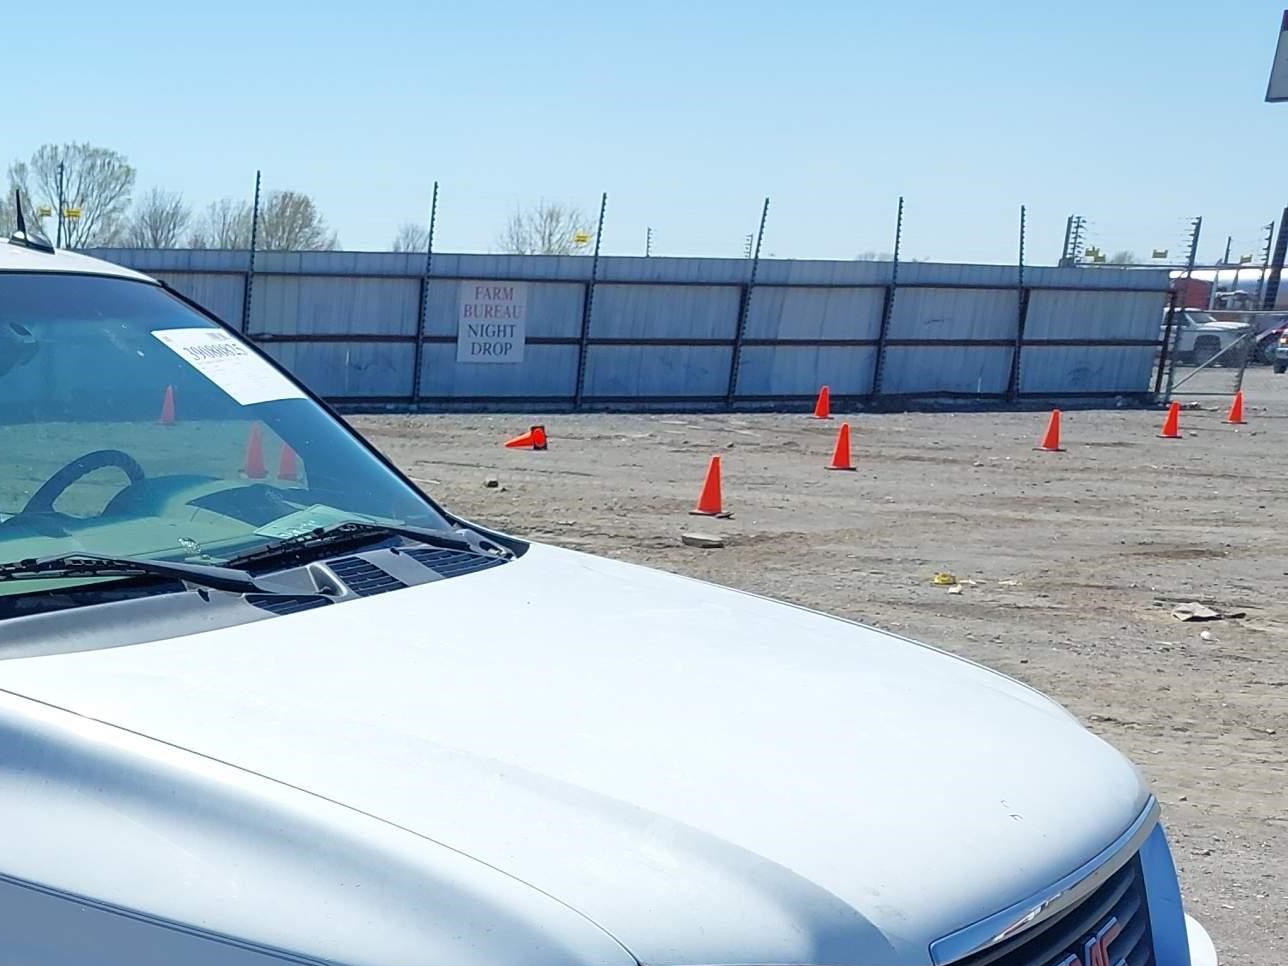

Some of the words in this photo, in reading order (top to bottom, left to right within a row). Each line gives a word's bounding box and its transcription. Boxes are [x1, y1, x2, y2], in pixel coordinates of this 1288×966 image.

[474, 286, 514, 300] FARM
[463, 303, 522, 319] BUREAU
[467, 323, 516, 338] NIGHT
[471, 341, 513, 356] DROP
